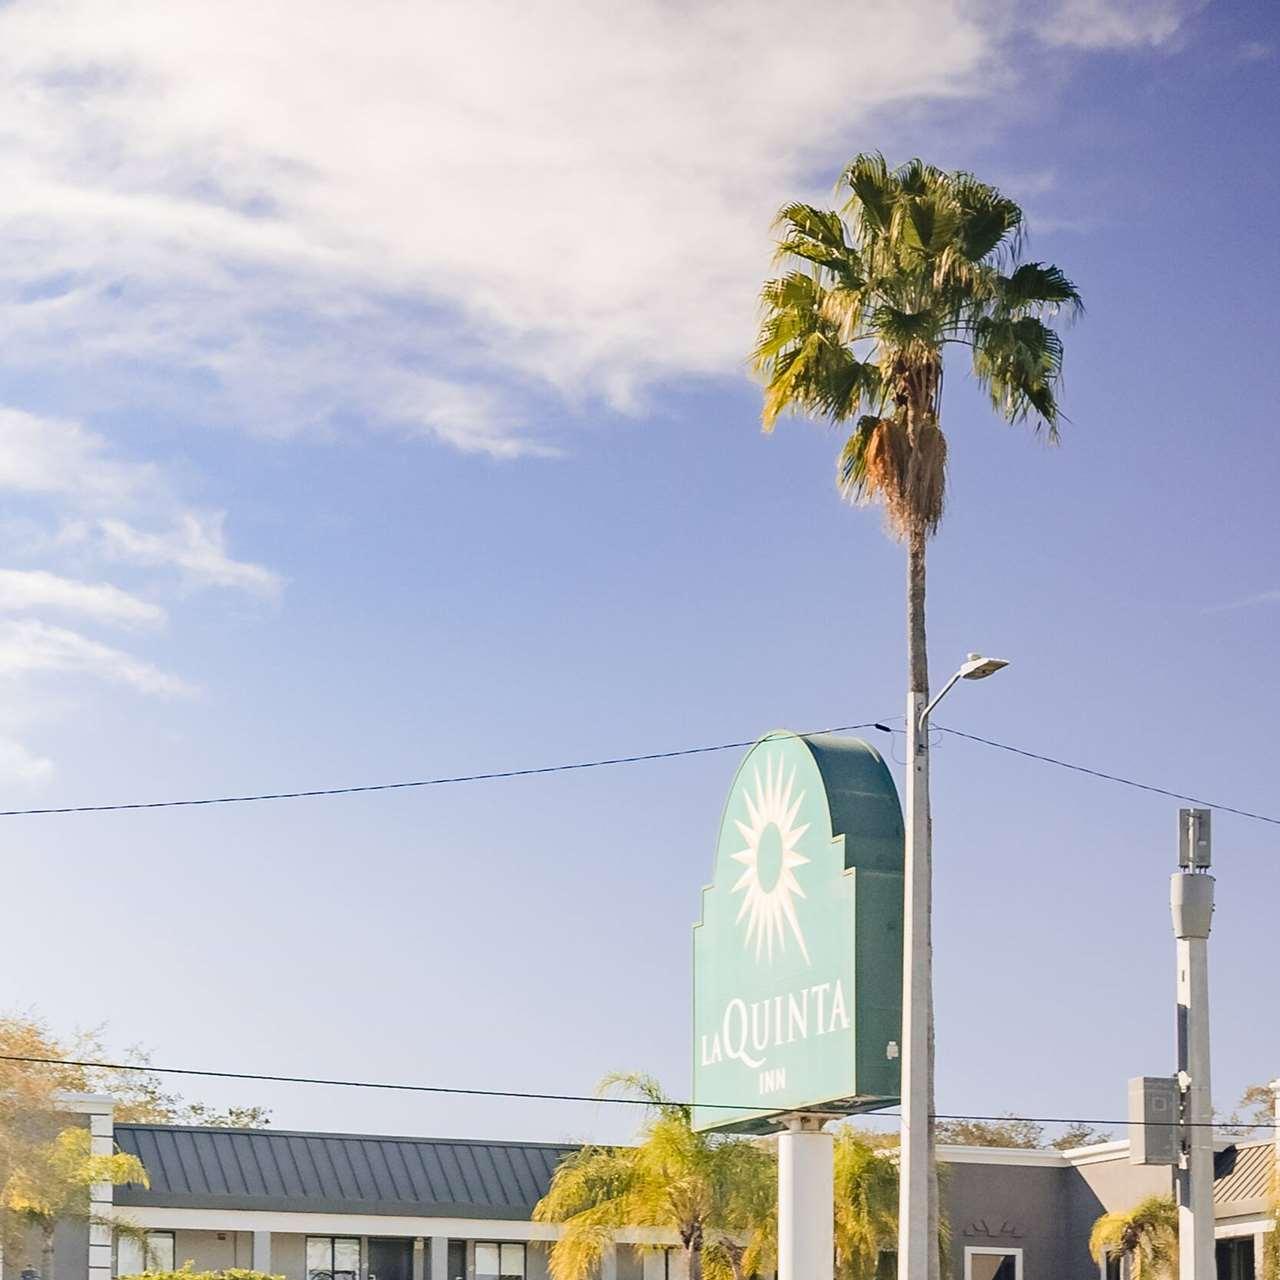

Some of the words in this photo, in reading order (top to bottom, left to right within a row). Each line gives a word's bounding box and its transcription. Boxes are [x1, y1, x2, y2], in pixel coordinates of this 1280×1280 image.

[701, 1032, 723, 1066] LA
[723, 978, 851, 1068] QUINTA
[759, 1067, 786, 1095] INN
